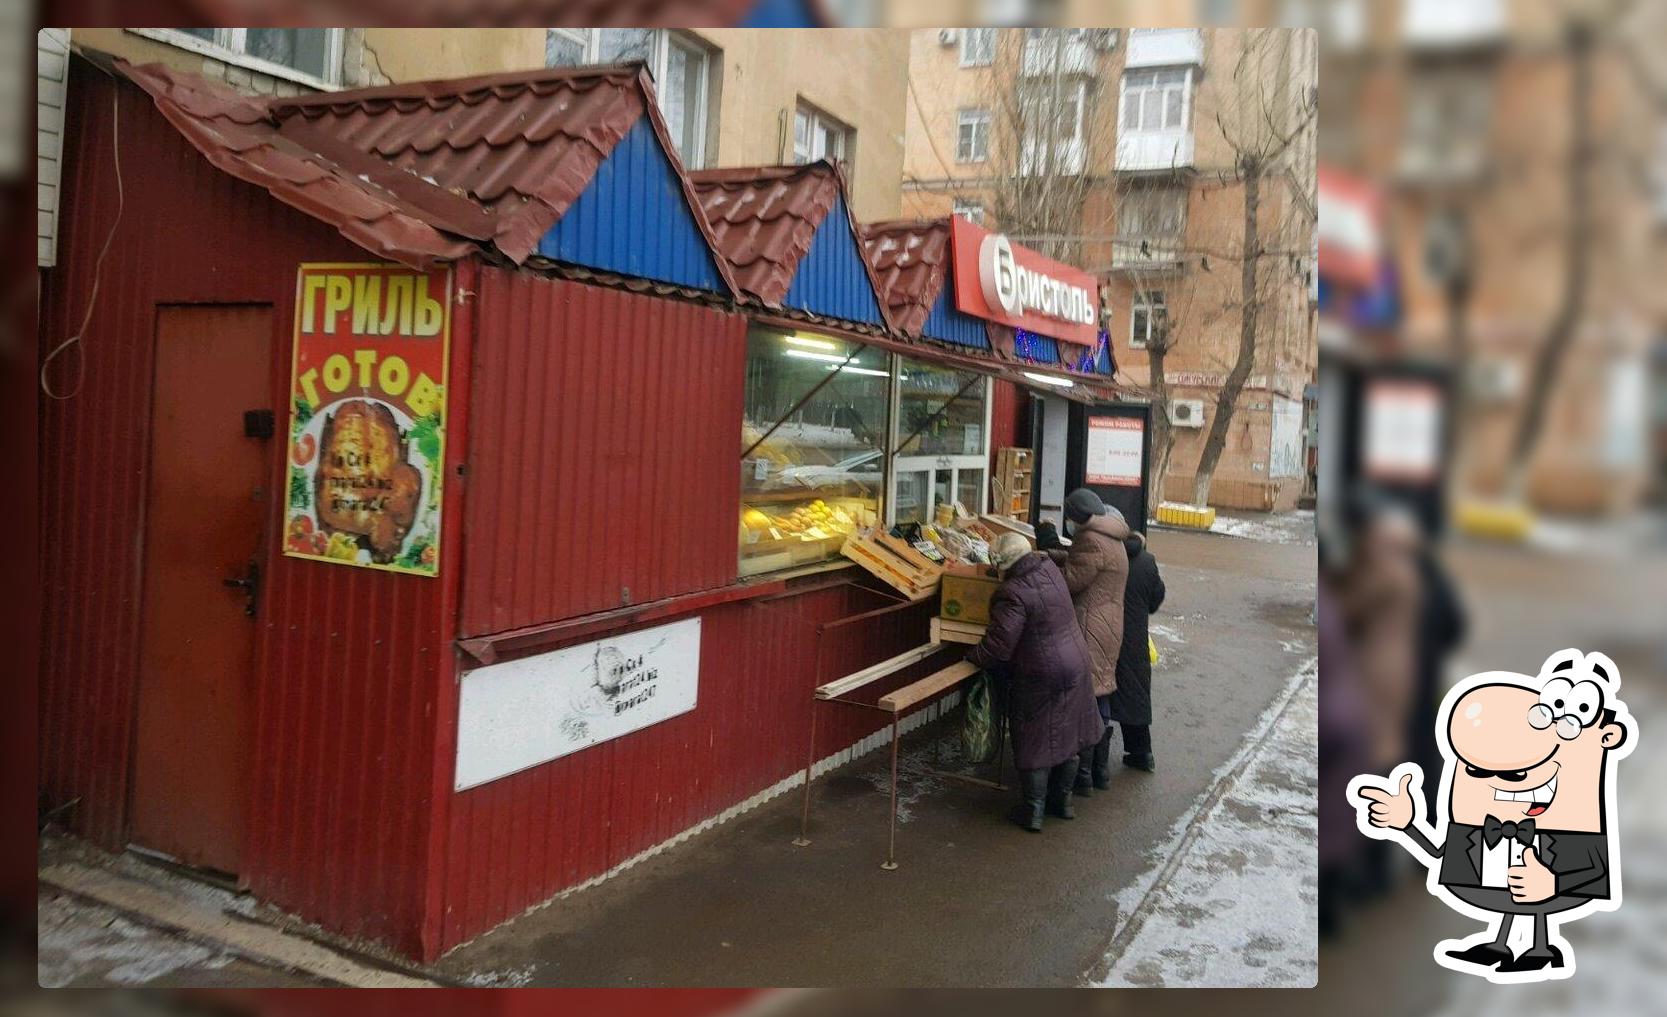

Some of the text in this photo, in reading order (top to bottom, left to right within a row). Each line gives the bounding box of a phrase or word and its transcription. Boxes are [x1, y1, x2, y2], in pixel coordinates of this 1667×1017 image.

[301, 274, 444, 337] ГРИЛЬ
[979, 233, 1095, 325] Бристоль
[299, 350, 439, 416] ГОТОВ
